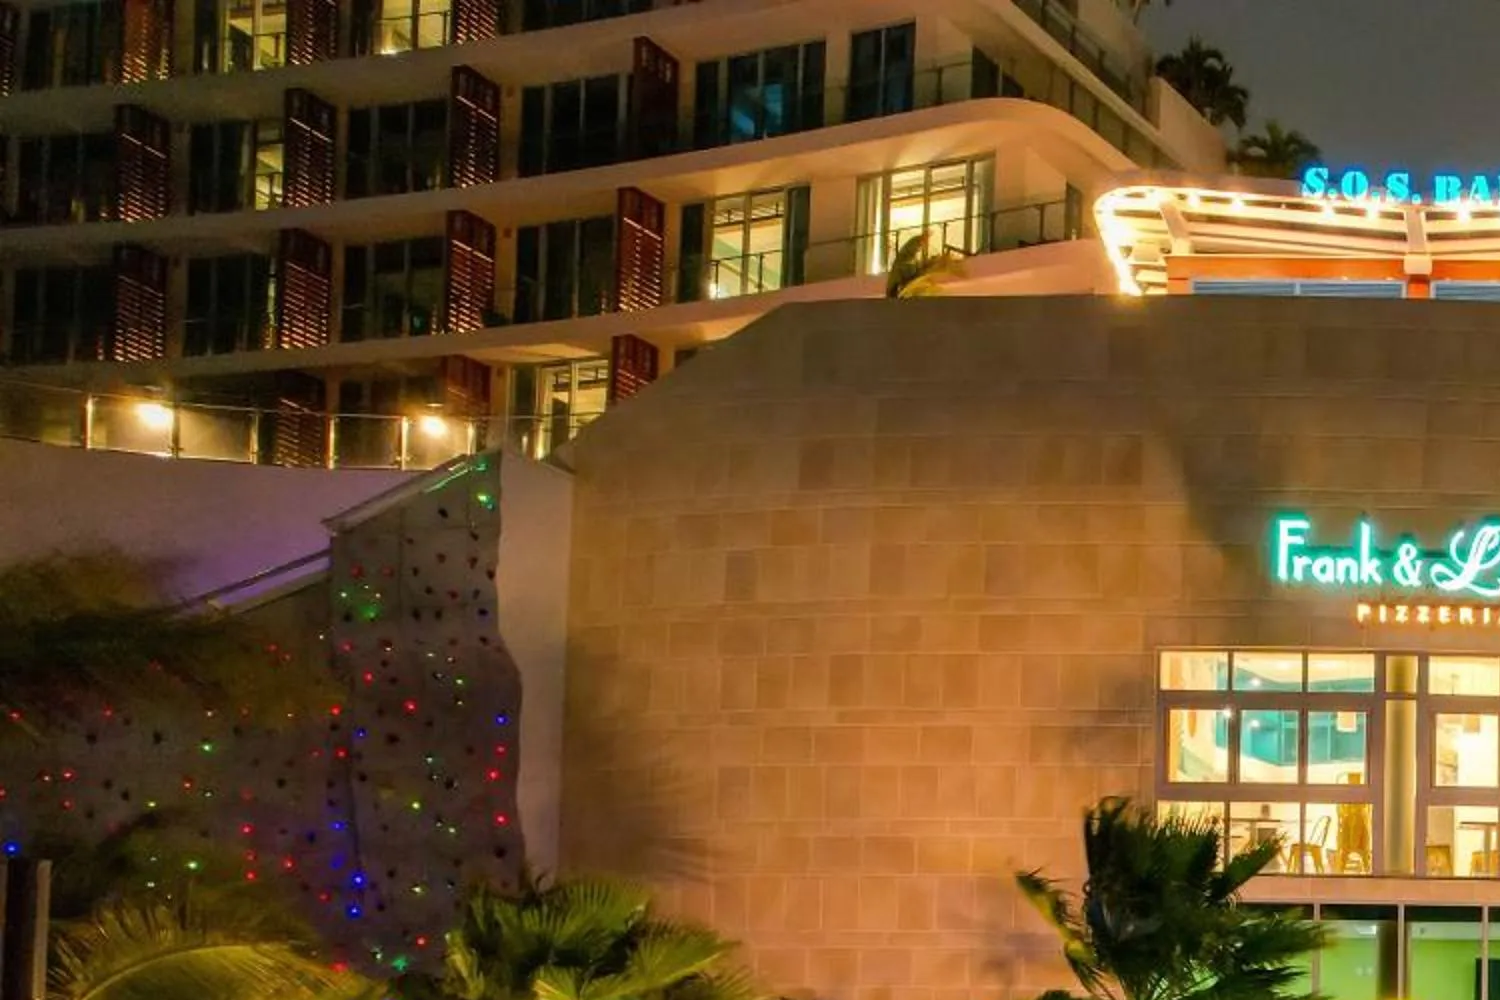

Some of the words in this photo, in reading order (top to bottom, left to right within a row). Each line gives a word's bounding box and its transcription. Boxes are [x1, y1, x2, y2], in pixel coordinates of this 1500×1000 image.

[1302, 166, 1421, 203] S.O.S.
[1277, 519, 1383, 583] Frank
[1393, 542, 1423, 587] &
